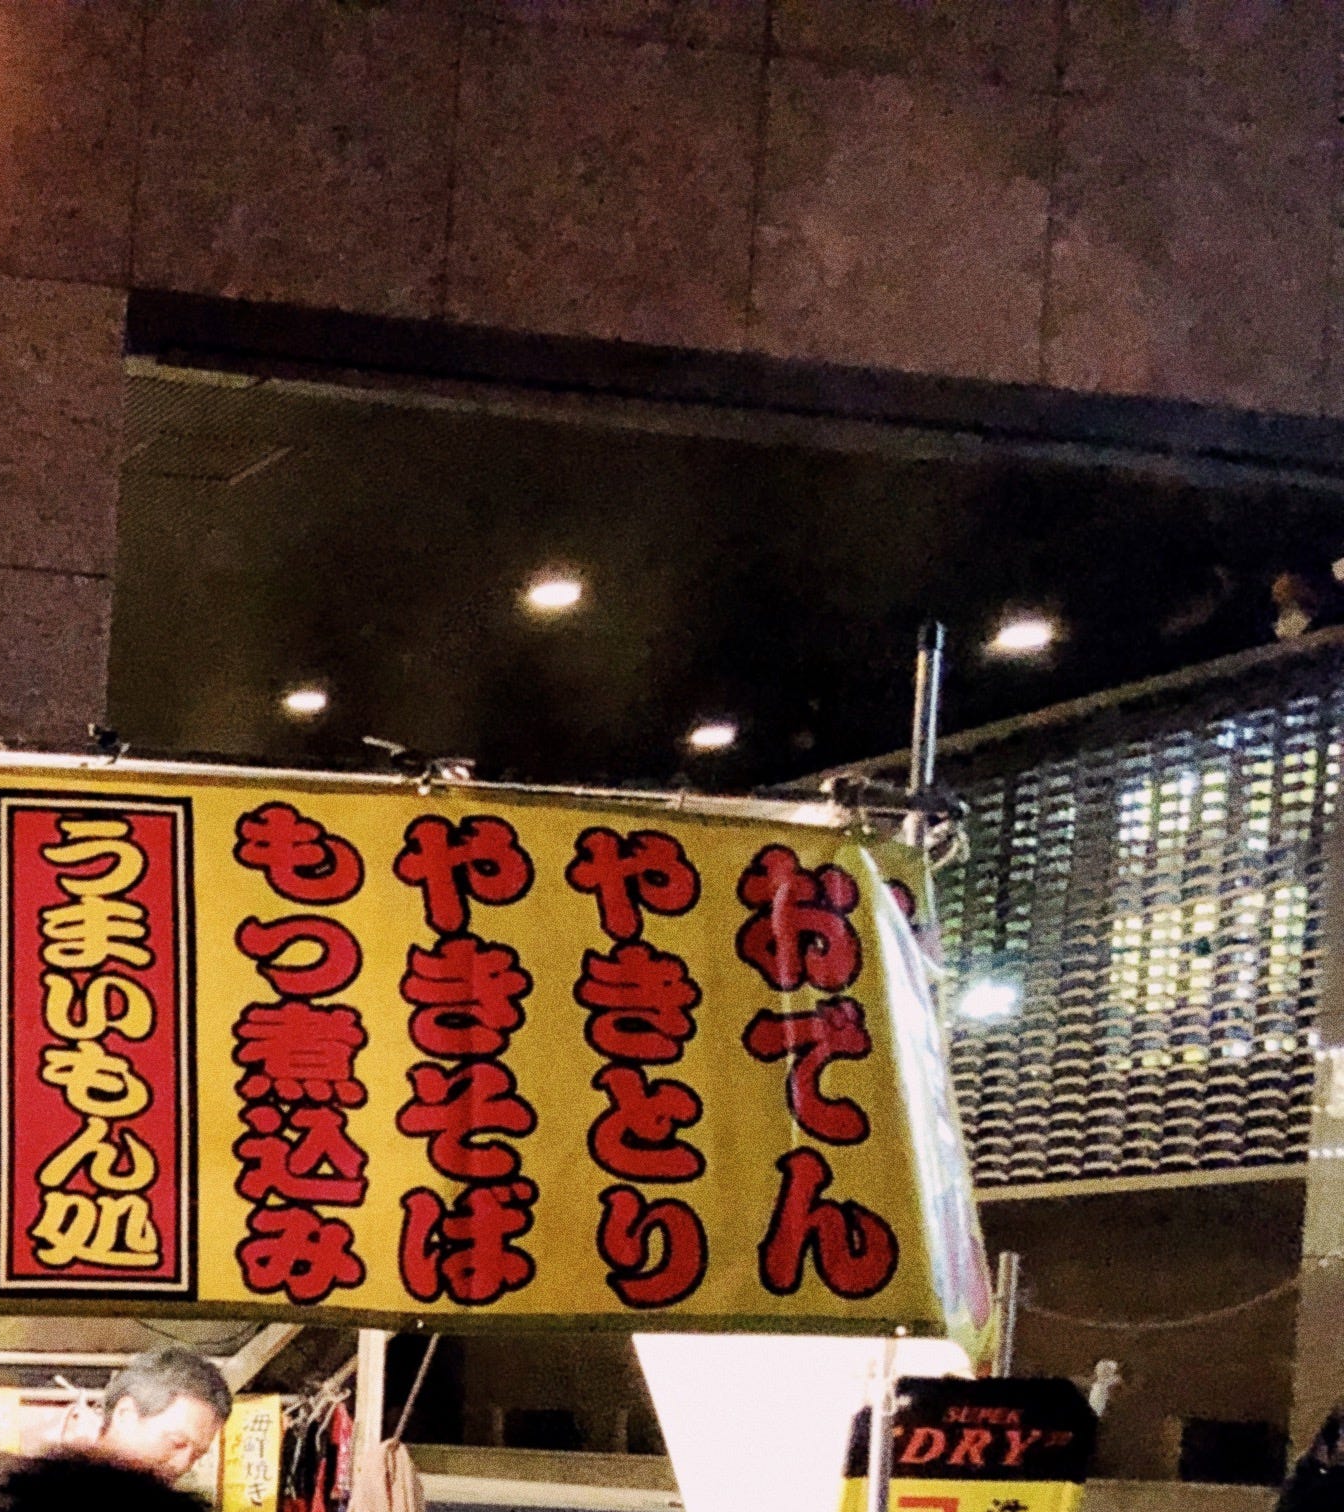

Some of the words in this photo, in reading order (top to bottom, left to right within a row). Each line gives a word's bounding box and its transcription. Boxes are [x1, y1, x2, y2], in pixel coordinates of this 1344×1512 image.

[32, 813, 162, 1272] うまいもん処
[231, 800, 371, 1305] もつ煮込み
[393, 813, 539, 1308] やきそば
[567, 825, 709, 1309] やきとり
[735, 843, 901, 1302] おでん
[243, 1412, 274, 1507] 海鮮焼き
